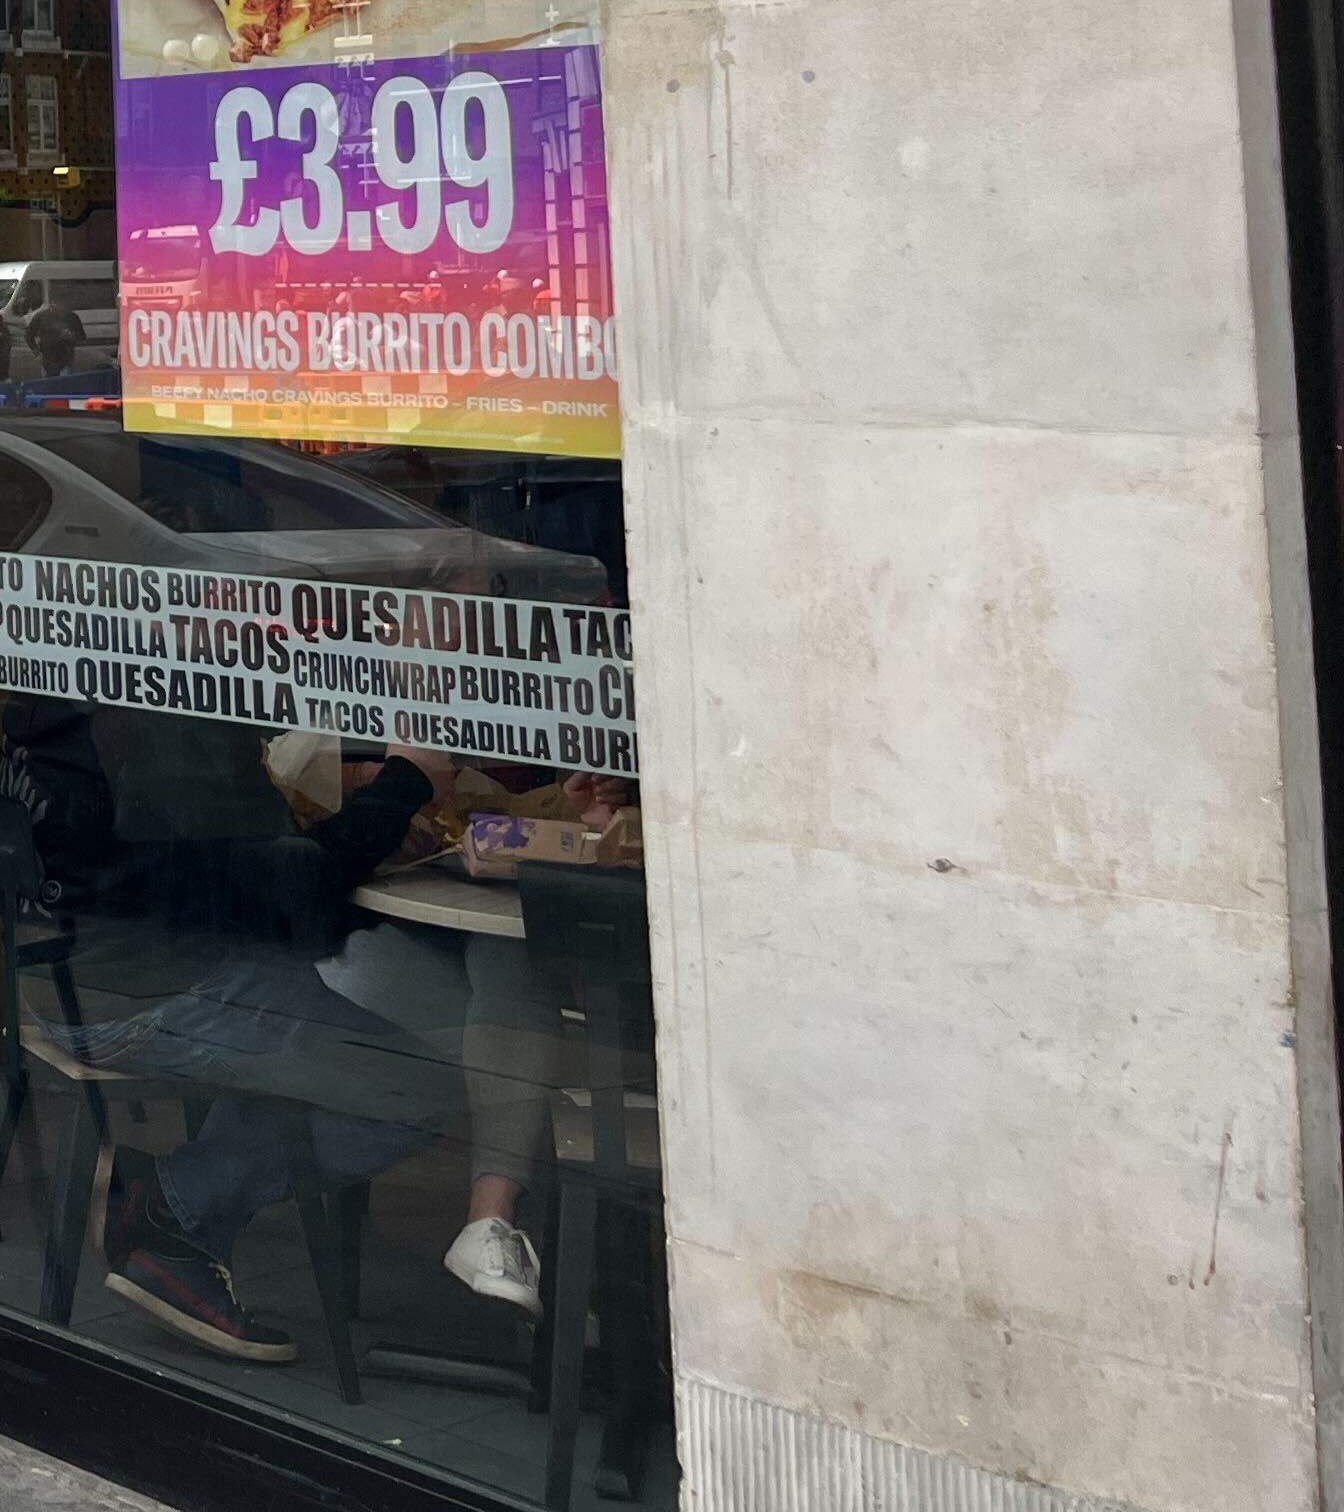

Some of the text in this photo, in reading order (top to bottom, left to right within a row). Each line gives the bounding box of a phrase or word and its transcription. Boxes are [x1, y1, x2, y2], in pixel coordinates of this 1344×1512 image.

[209, 71, 513, 256] £3.99
[128, 309, 300, 371] CRAVINGS
[312, 311, 471, 377] BURRITO
[151, 385, 202, 399] BEEFY
[208, 387, 268, 403] NACHO
[272, 389, 362, 406] CRAVINGS
[367, 393, 449, 409] BURRITO
[467, 396, 523, 413] FRIES
[542, 400, 608, 417] DRINK
[6, 603, 168, 659] QUESADILLA
[170, 614, 291, 675] TACOS
[293, 648, 456, 705] CRUNCHWRAP
[459, 665, 594, 716] BURRITO
[35, 559, 161, 613] NACHOS
[167, 572, 282, 616] BURRITO
[291, 583, 561, 664] QUESADILLA
[76, 657, 298, 726] QUESADILLA
[305, 697, 385, 737] TACOS
[394, 710, 552, 761] QUESADILLA
[558, 722, 639, 773] BUR
